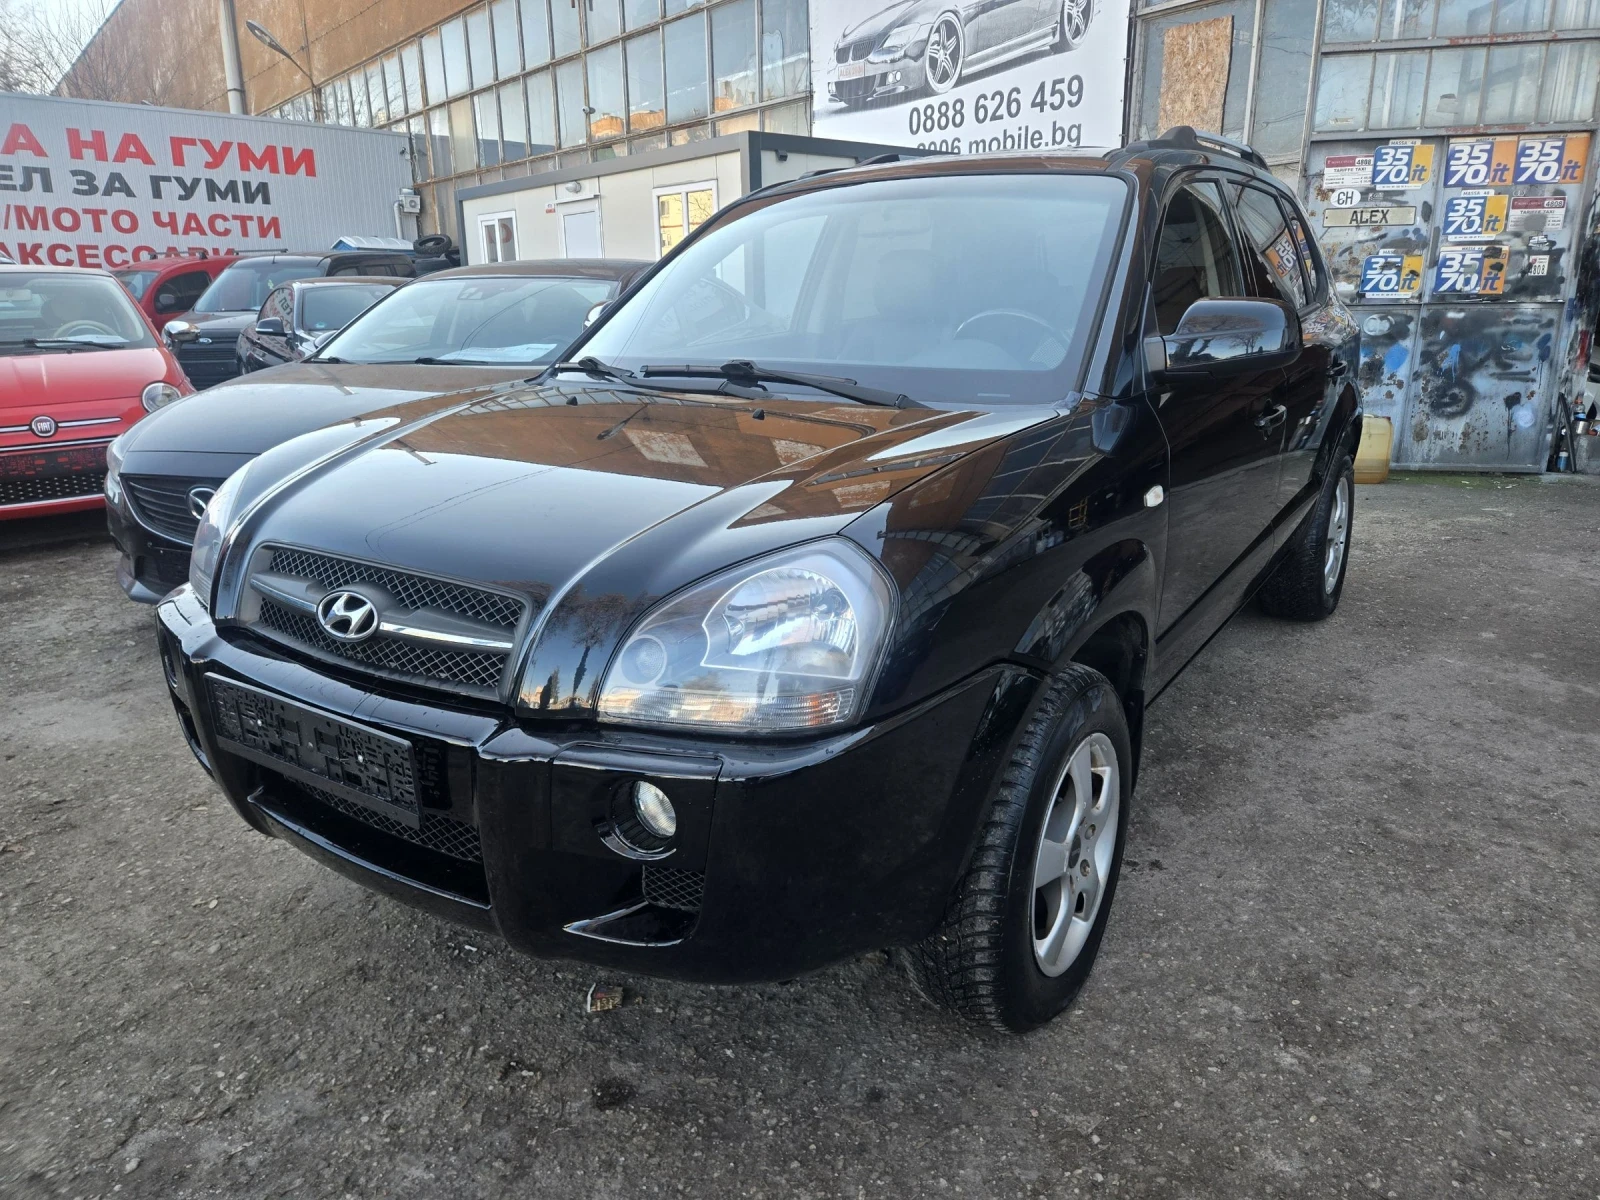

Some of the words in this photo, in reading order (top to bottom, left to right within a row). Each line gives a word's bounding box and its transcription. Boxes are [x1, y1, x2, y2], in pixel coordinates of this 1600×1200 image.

[909, 98, 965, 135] 0888
[974, 86, 1021, 124] 626
[1030, 74, 1084, 113] 459
[2, 123, 49, 158] А
[66, 128, 156, 165] НА
[169, 136, 317, 178] ГУМИ
[1376, 148, 1412, 166] 35
[1449, 144, 1491, 165] 35
[1520, 141, 1563, 162] 35
[69, 169, 137, 198] ЗА
[149, 174, 271, 205] ГУМИ
[1349, 209, 1390, 225] ALEX
[1448, 198, 1485, 217] 35
[152, 211, 282, 239] ЧАСТИ
[1366, 257, 1402, 274] 35
[1441, 253, 1483, 273] 35
[37, 421, 51, 432] FIAT
